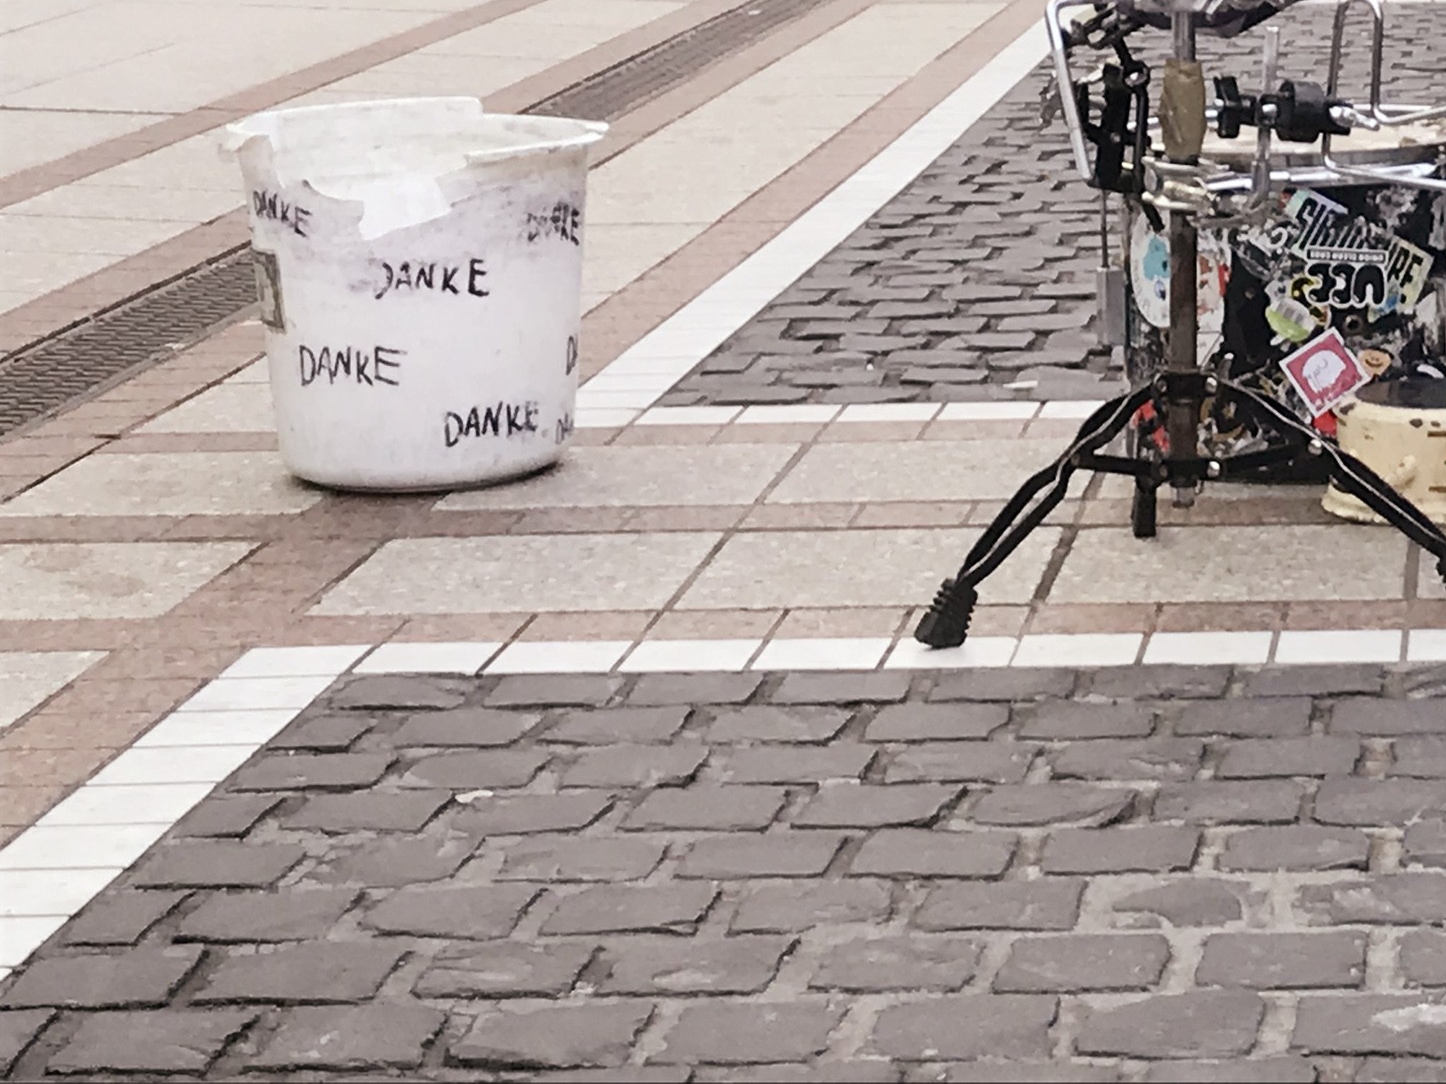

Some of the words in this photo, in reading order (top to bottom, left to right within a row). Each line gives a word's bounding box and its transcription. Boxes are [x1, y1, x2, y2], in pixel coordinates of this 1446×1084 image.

[253, 190, 313, 238] DANKE
[299, 344, 407, 387] DANKE
[444, 401, 539, 447] DANKE
